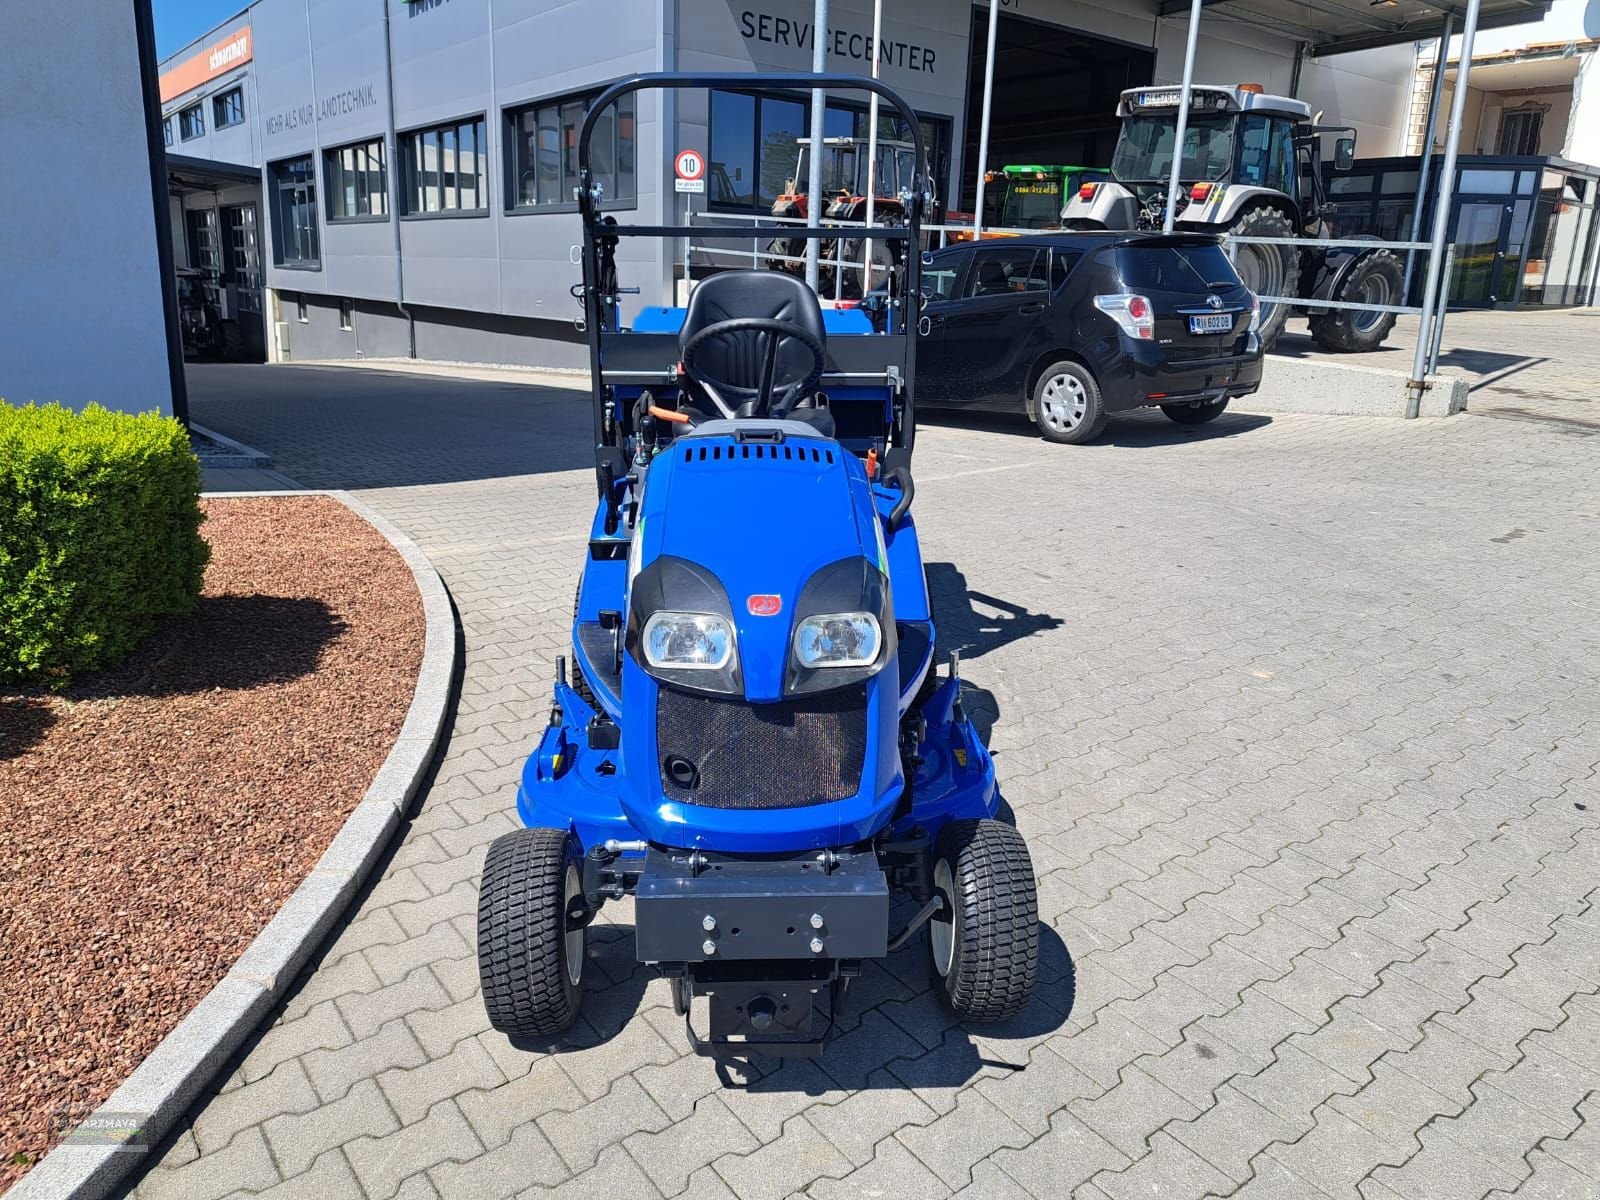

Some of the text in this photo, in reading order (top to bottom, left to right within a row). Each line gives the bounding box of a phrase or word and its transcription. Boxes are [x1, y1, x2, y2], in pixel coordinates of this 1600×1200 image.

[266, 84, 377, 136] MEHR ALS NUR LANDTECHNIK.
[684, 158, 695, 173] 10
